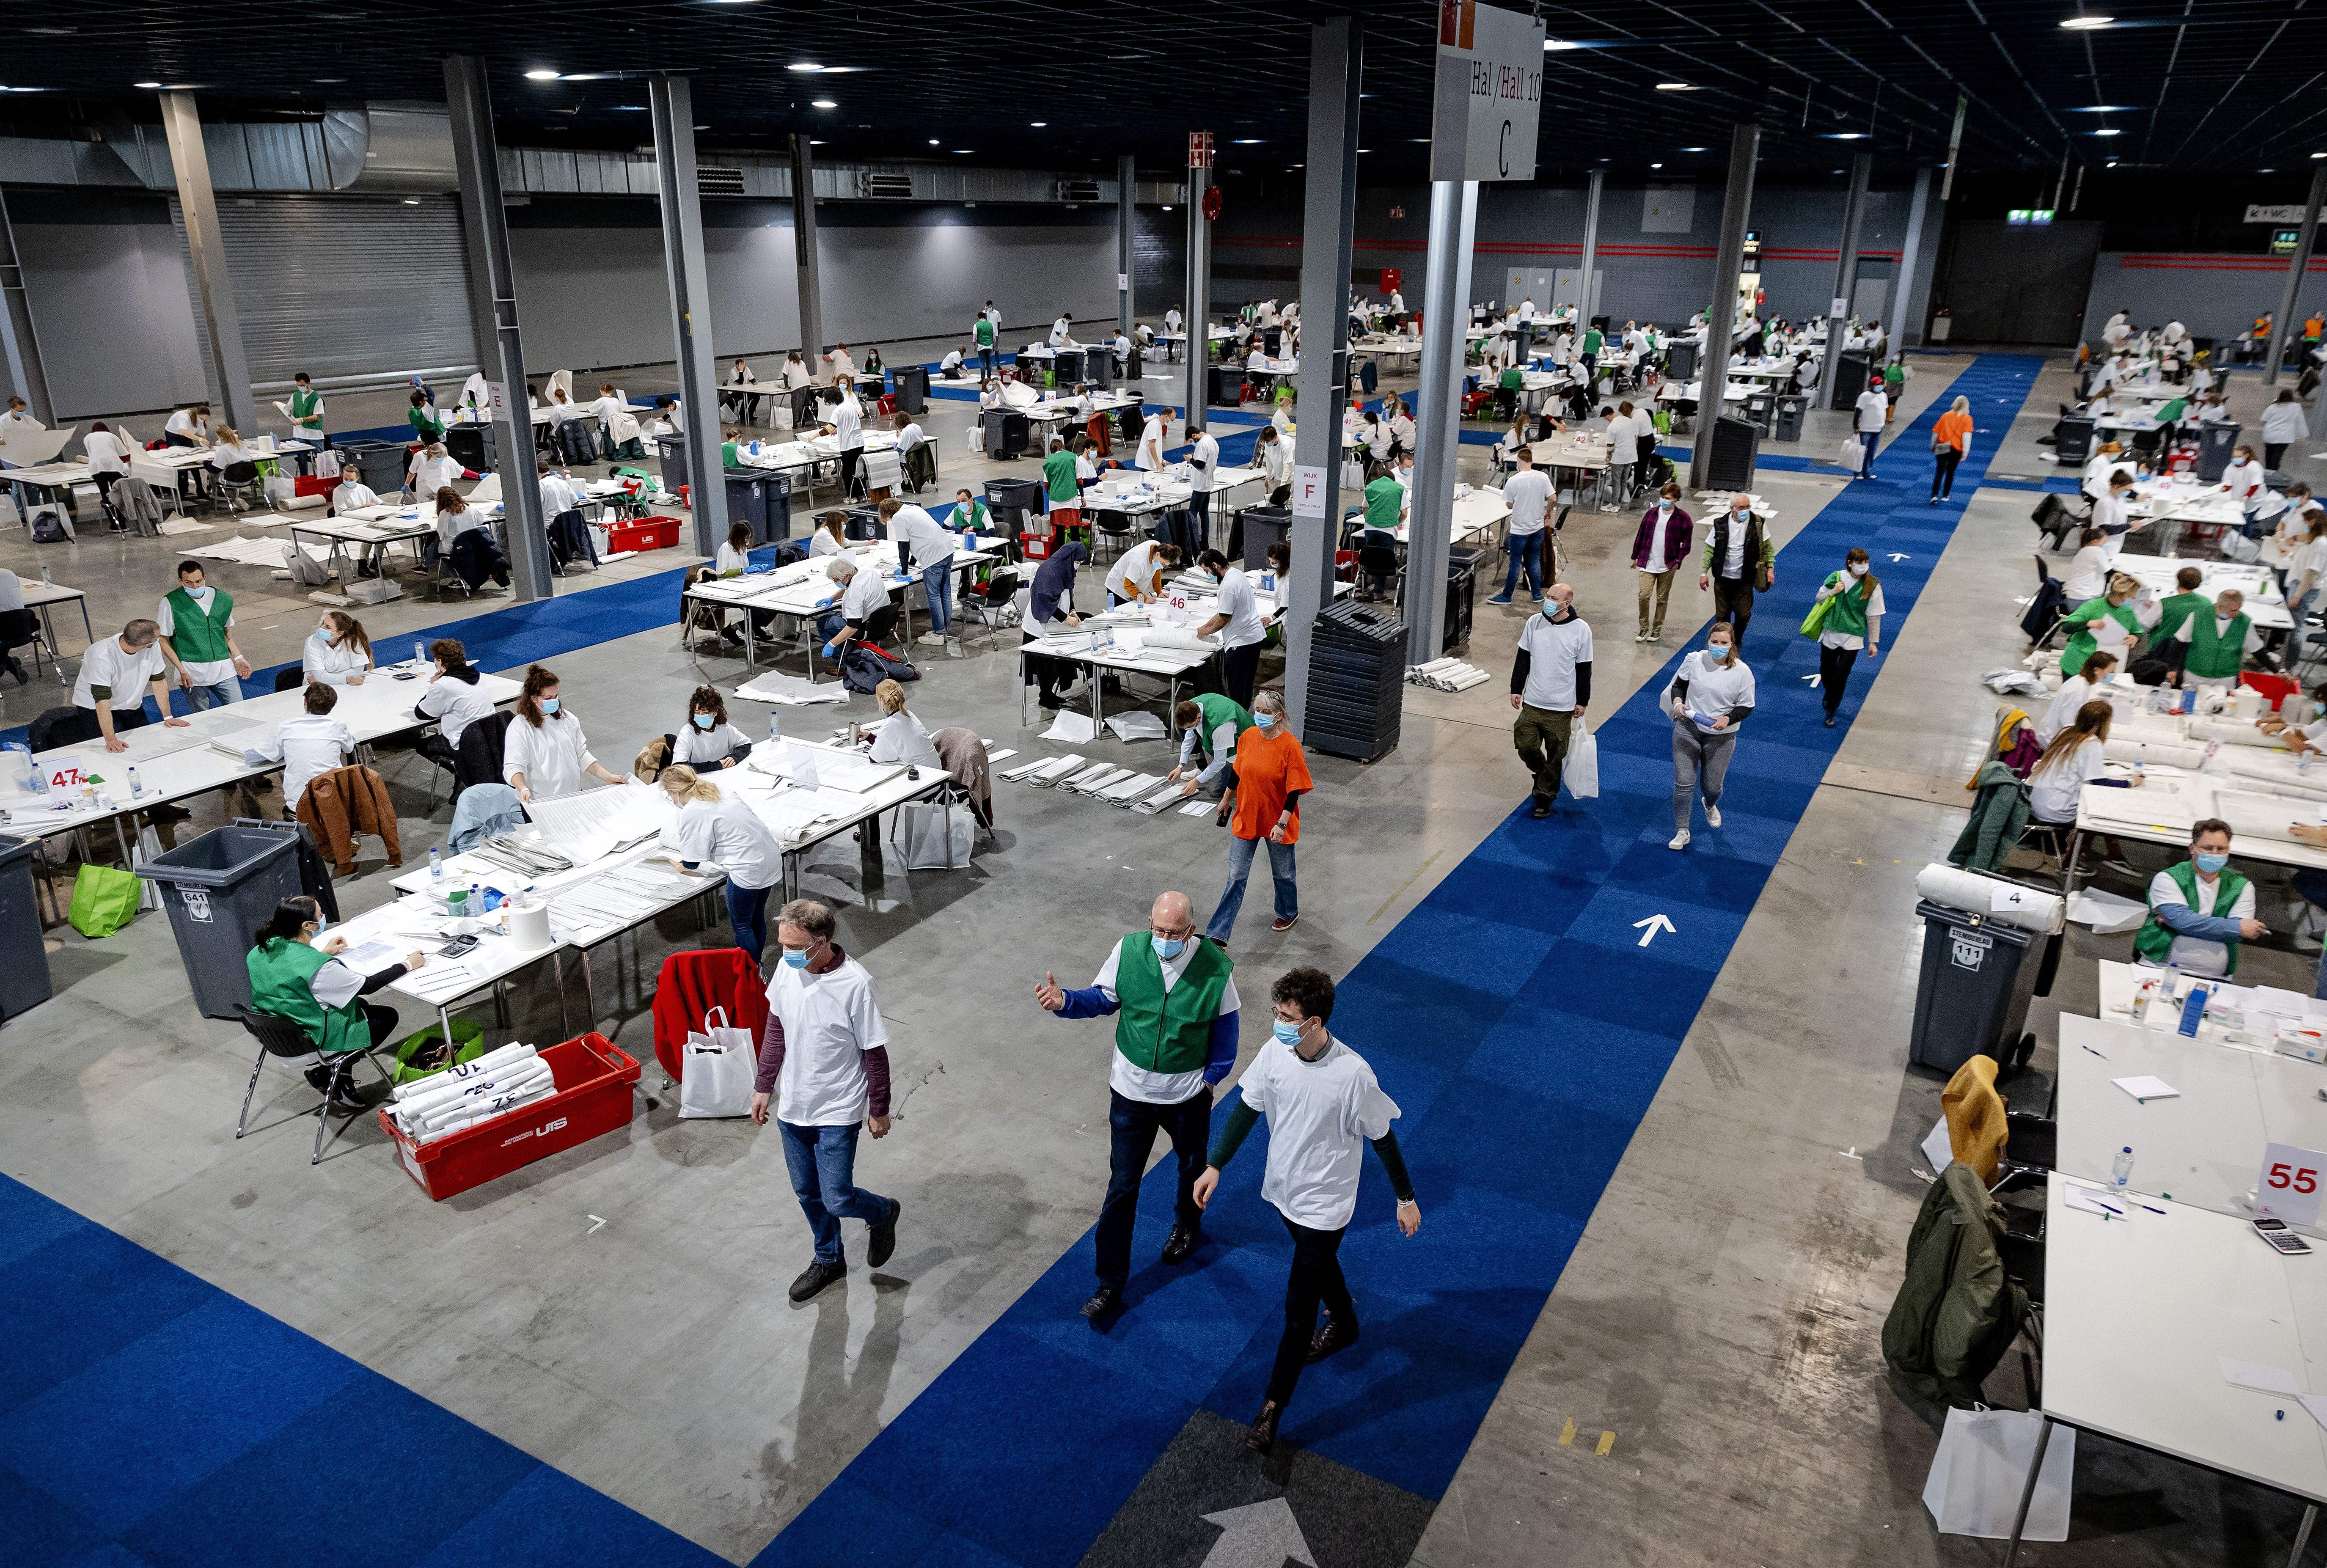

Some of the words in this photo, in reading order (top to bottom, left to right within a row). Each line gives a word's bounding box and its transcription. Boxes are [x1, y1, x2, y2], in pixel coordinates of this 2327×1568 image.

[1472, 61, 1491, 96] Hal
[1528, 72, 1540, 102] 10
[1499, 120, 1511, 178] C
[494, 396, 501, 407] E
[1305, 484, 1315, 498] F
[1169, 597, 1185, 609] 46
[52, 768, 79, 787] 47
[185, 893, 205, 902] 641
[2010, 892, 2022, 904] 4
[1957, 945, 1980, 958] 111
[536, 1117, 567, 1137] UTS
[504, 1130, 534, 1143] INTERNATIONAL
[2267, 1163, 2318, 1194] 55
